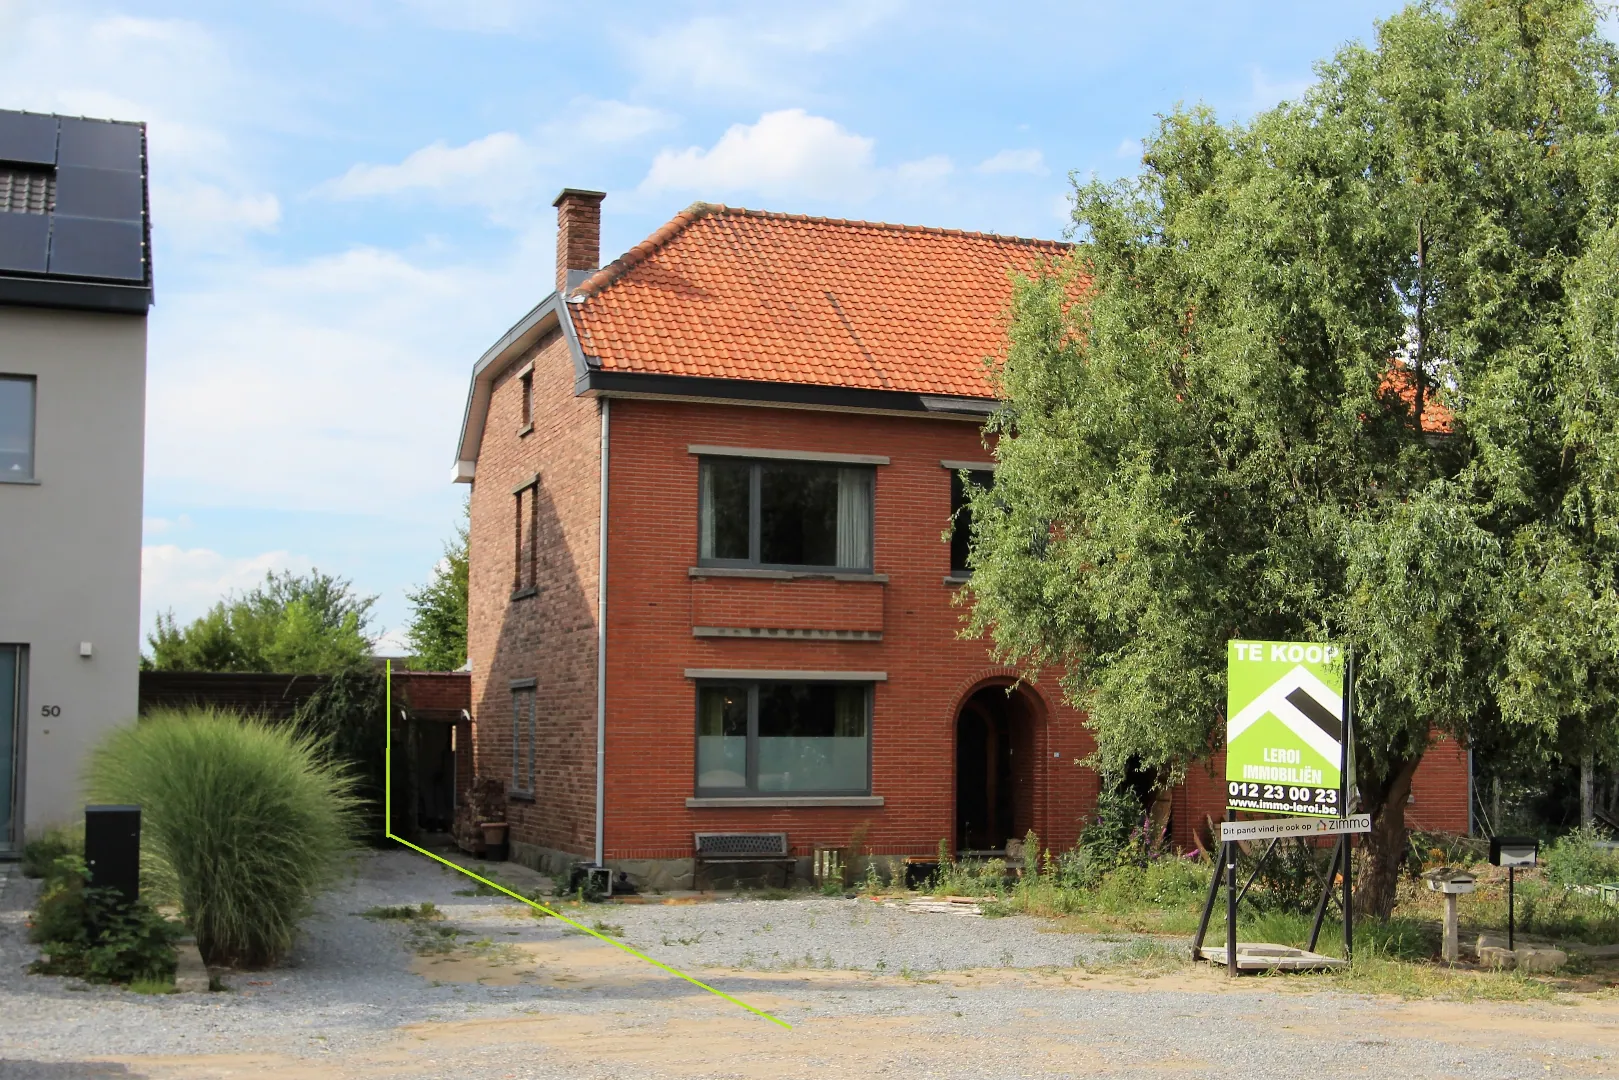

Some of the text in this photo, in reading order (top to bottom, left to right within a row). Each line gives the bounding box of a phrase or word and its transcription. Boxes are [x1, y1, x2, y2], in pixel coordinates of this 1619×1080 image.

[1234, 643, 1338, 663] TE KOOP
[41, 705, 61, 717] 50
[1264, 748, 1300, 764] LEROI
[1243, 765, 1322, 784] IMMOBILIËN
[1228, 782, 1337, 804] 012 23 00 23
[1228, 798, 1337, 815] www.immo-leroi.be
[1223, 817, 1370, 836] Dit pand vind je ook op zimmo
